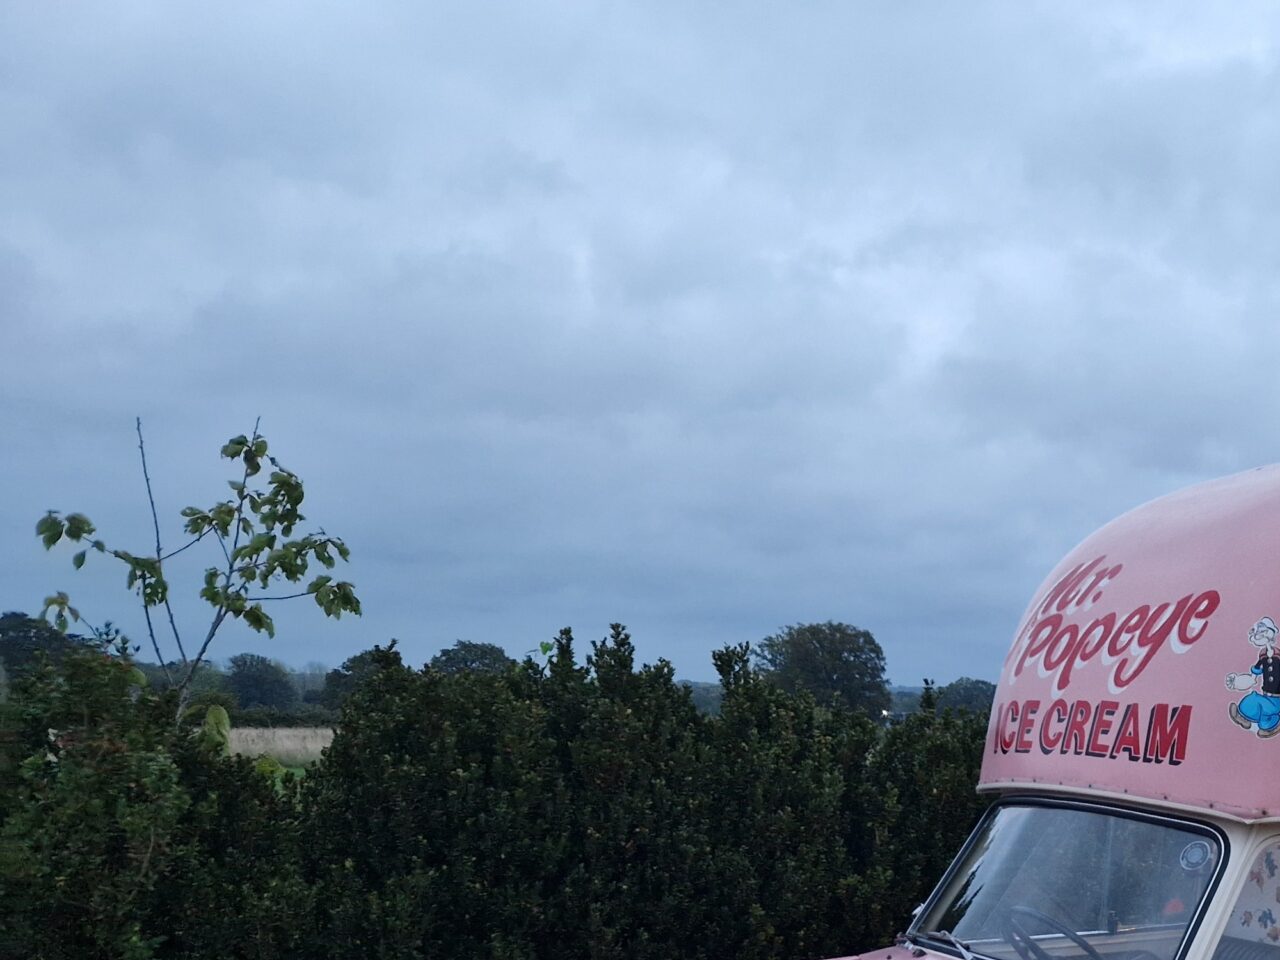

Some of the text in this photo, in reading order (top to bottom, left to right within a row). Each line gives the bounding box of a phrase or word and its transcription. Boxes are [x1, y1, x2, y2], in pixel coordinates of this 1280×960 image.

[1014, 590, 1221, 691] Popeye
[993, 698, 1192, 766] ICE CREAM
